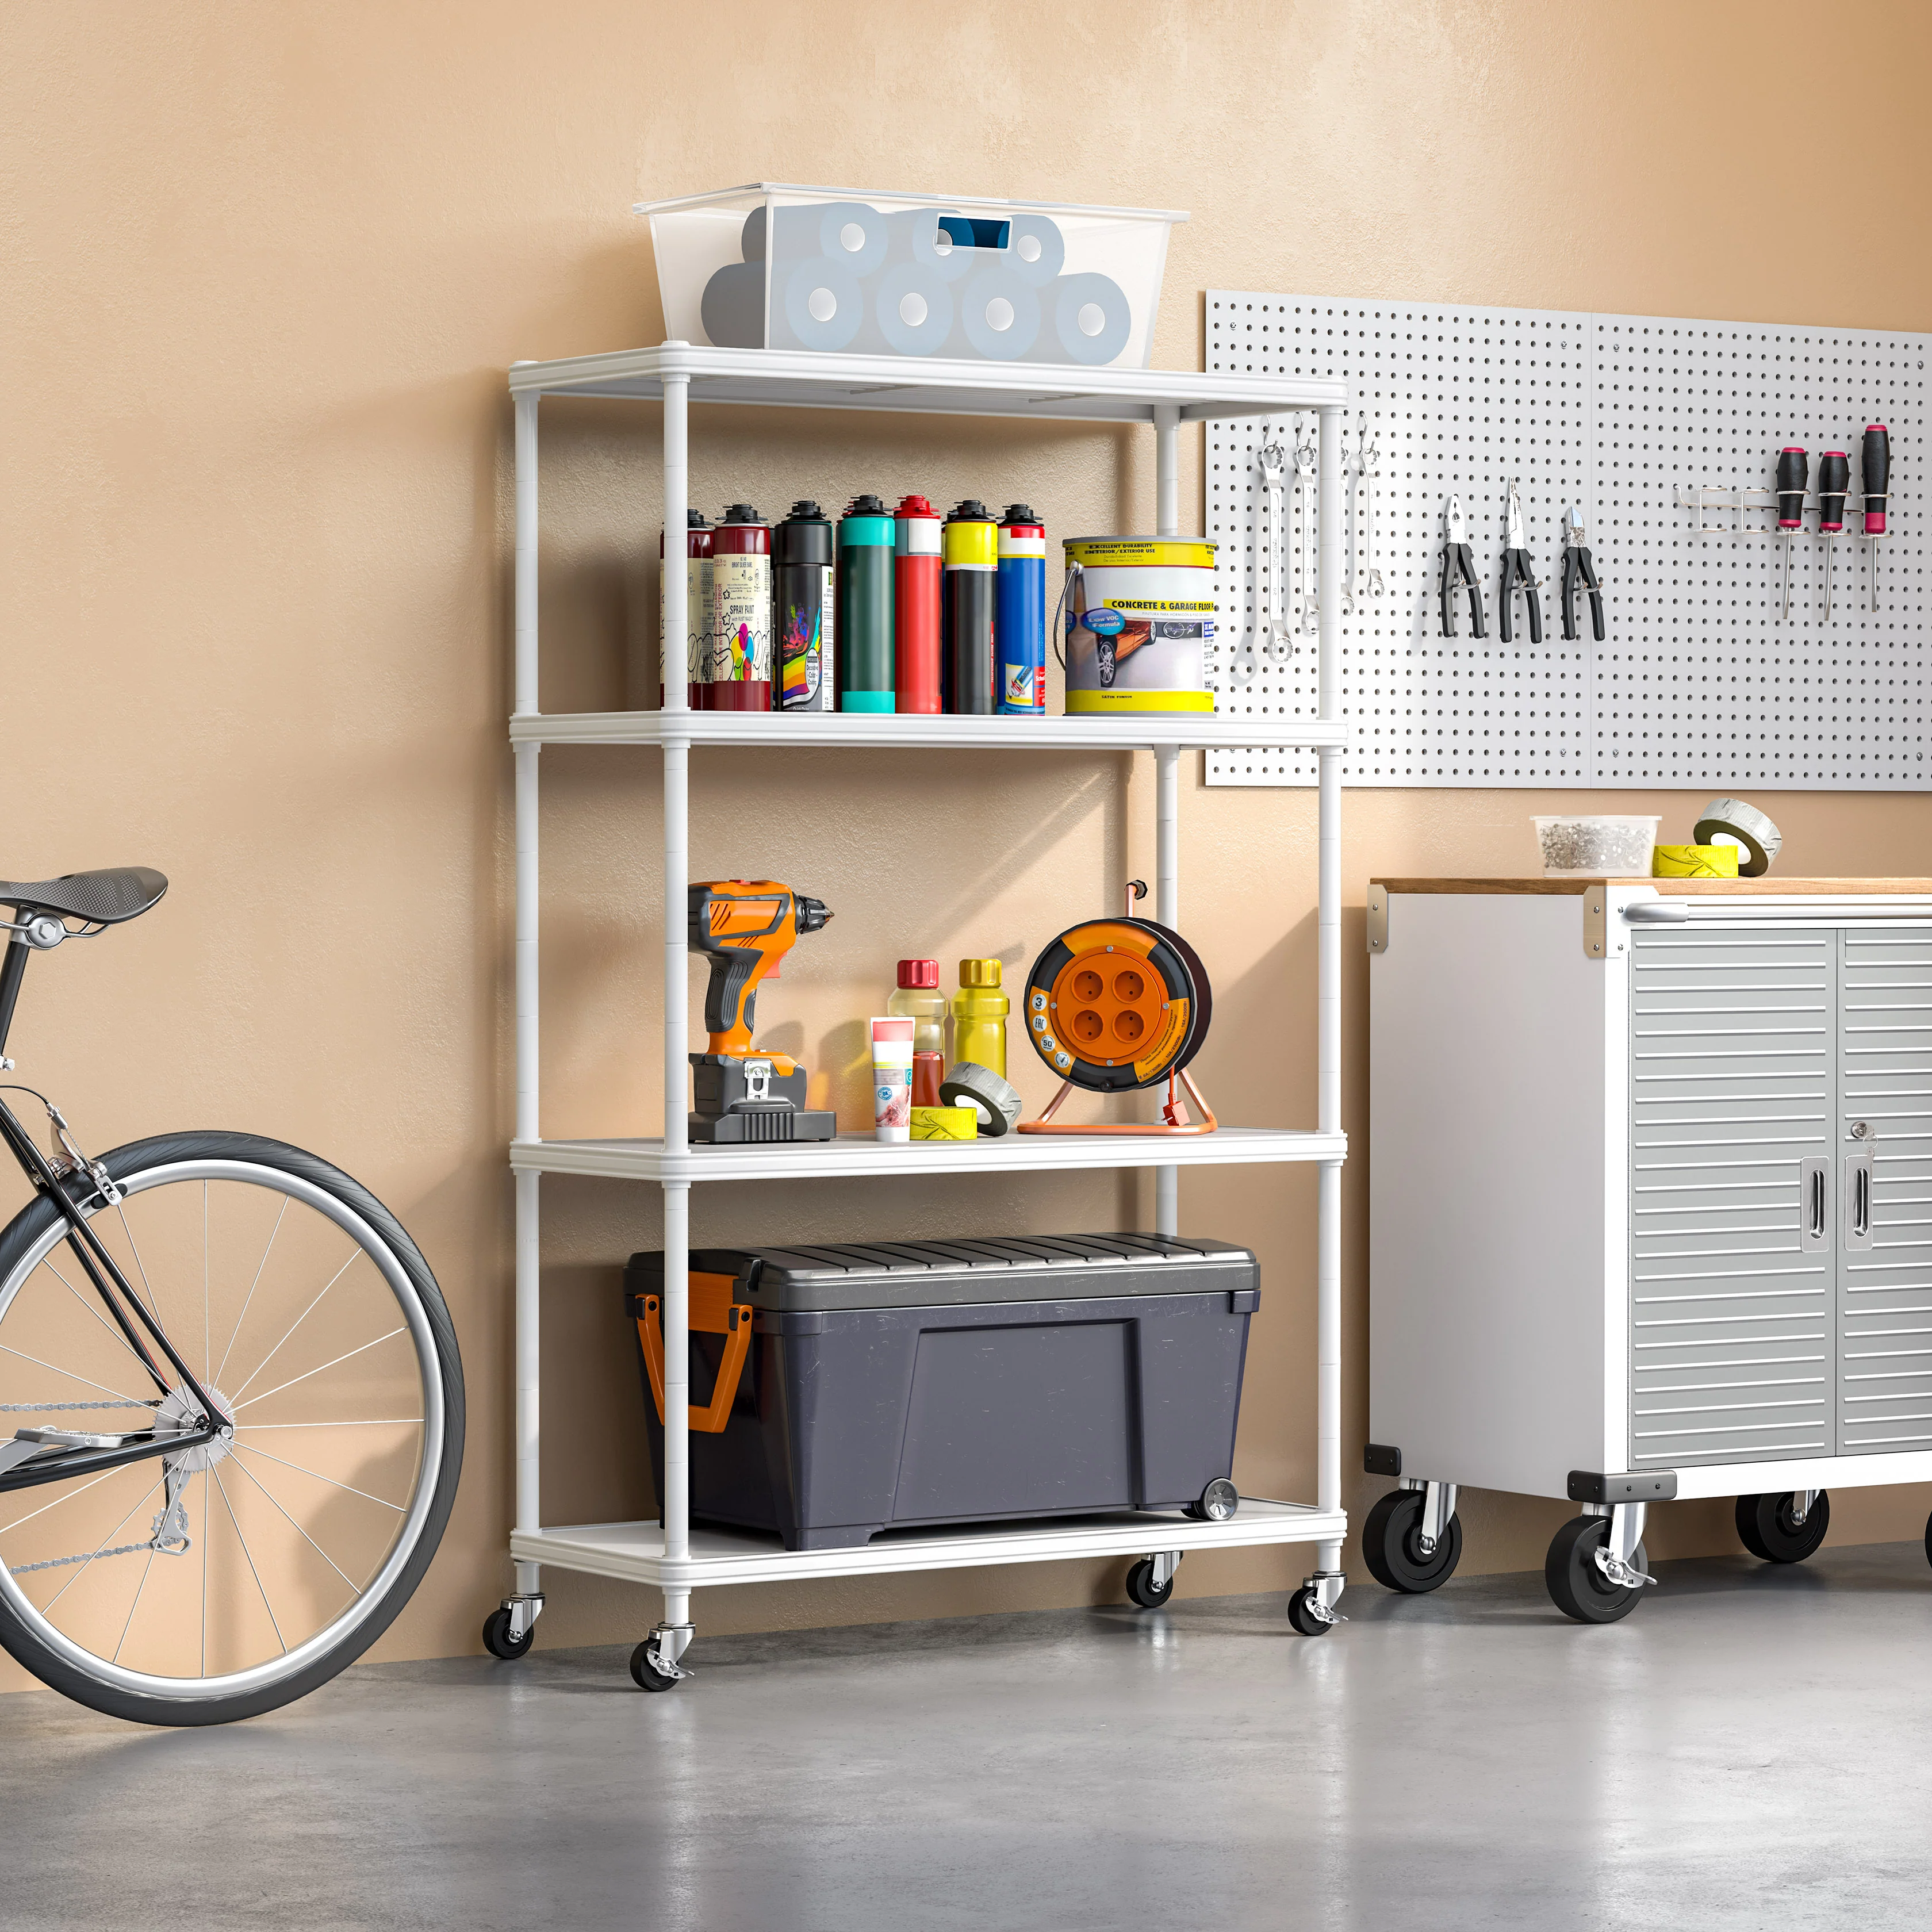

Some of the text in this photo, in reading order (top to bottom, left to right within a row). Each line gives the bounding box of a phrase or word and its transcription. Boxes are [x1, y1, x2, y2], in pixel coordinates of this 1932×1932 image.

[730, 605, 754, 615] SPRAY PAINT
[1111, 600, 1157, 610] CONCRETE
[1169, 602, 1197, 611] GARAGE
[1198, 602, 1211, 611] FLOOR
[719, 611, 723, 619] OR
[1036, 997, 1042, 1007] 3
